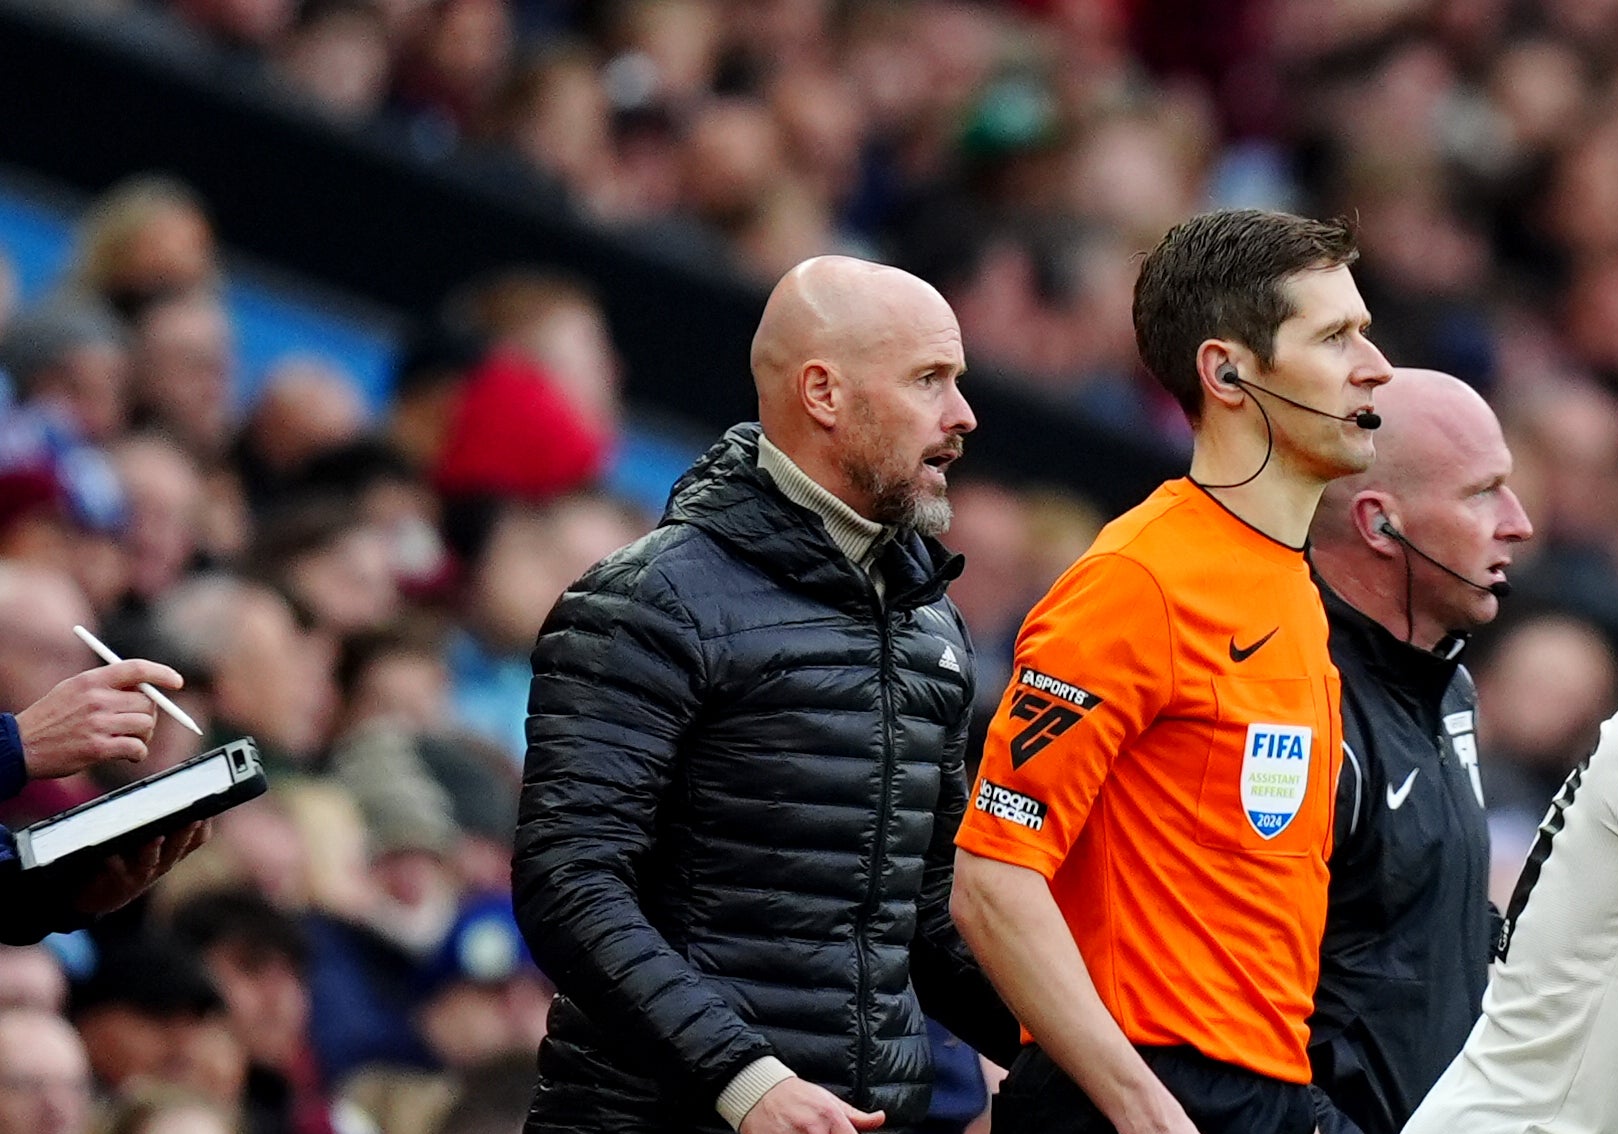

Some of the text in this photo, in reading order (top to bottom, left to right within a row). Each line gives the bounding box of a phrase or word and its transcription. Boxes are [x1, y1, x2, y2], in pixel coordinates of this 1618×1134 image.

[1034, 673, 1086, 705] SPORTS
[1251, 733, 1303, 760] FIFA
[1248, 772, 1301, 785] ASSISTANT
[1250, 785, 1296, 799] REFEREE
[975, 795, 1043, 831] or racism
[992, 786, 1040, 815] room
[1257, 813, 1283, 828] 2024
